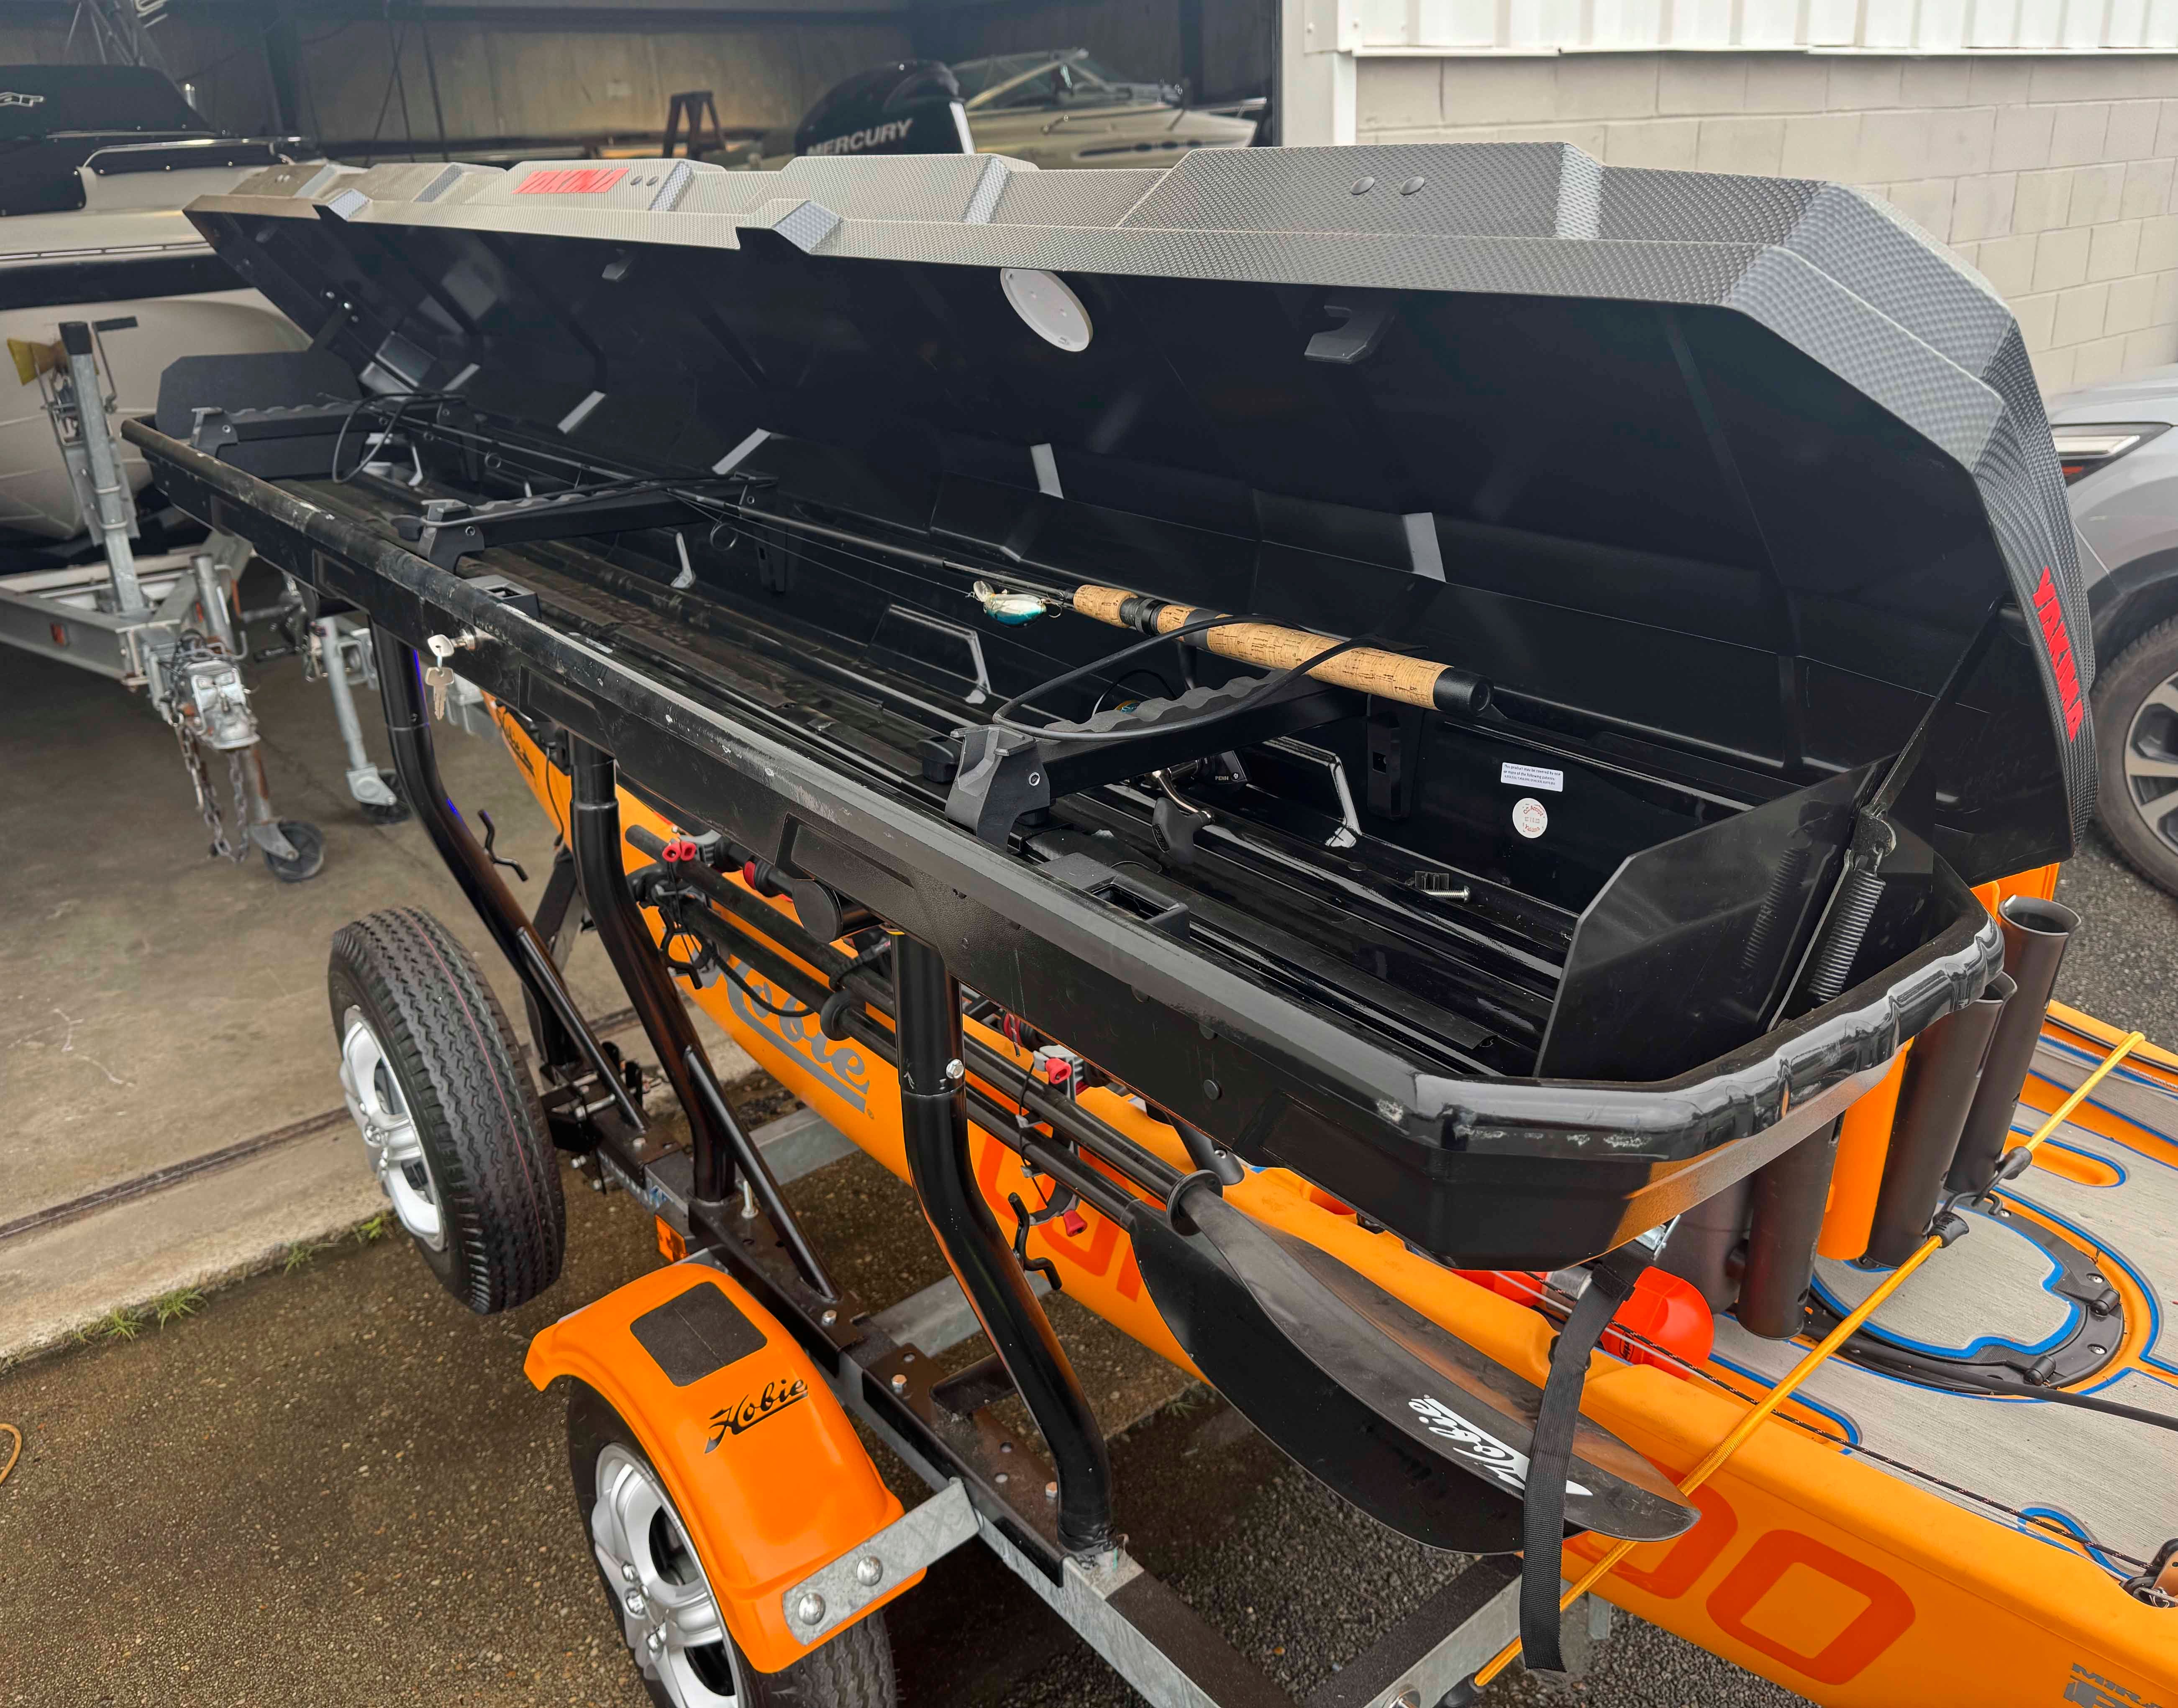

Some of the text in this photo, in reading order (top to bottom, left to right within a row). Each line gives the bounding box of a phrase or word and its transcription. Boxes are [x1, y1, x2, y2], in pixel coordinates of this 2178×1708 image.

[806, 118, 914, 156] MERCURY
[511, 167, 630, 194] YAKIMA
[2032, 565, 2084, 743] YAKIMA
[704, 1377, 808, 1454] Hobie
